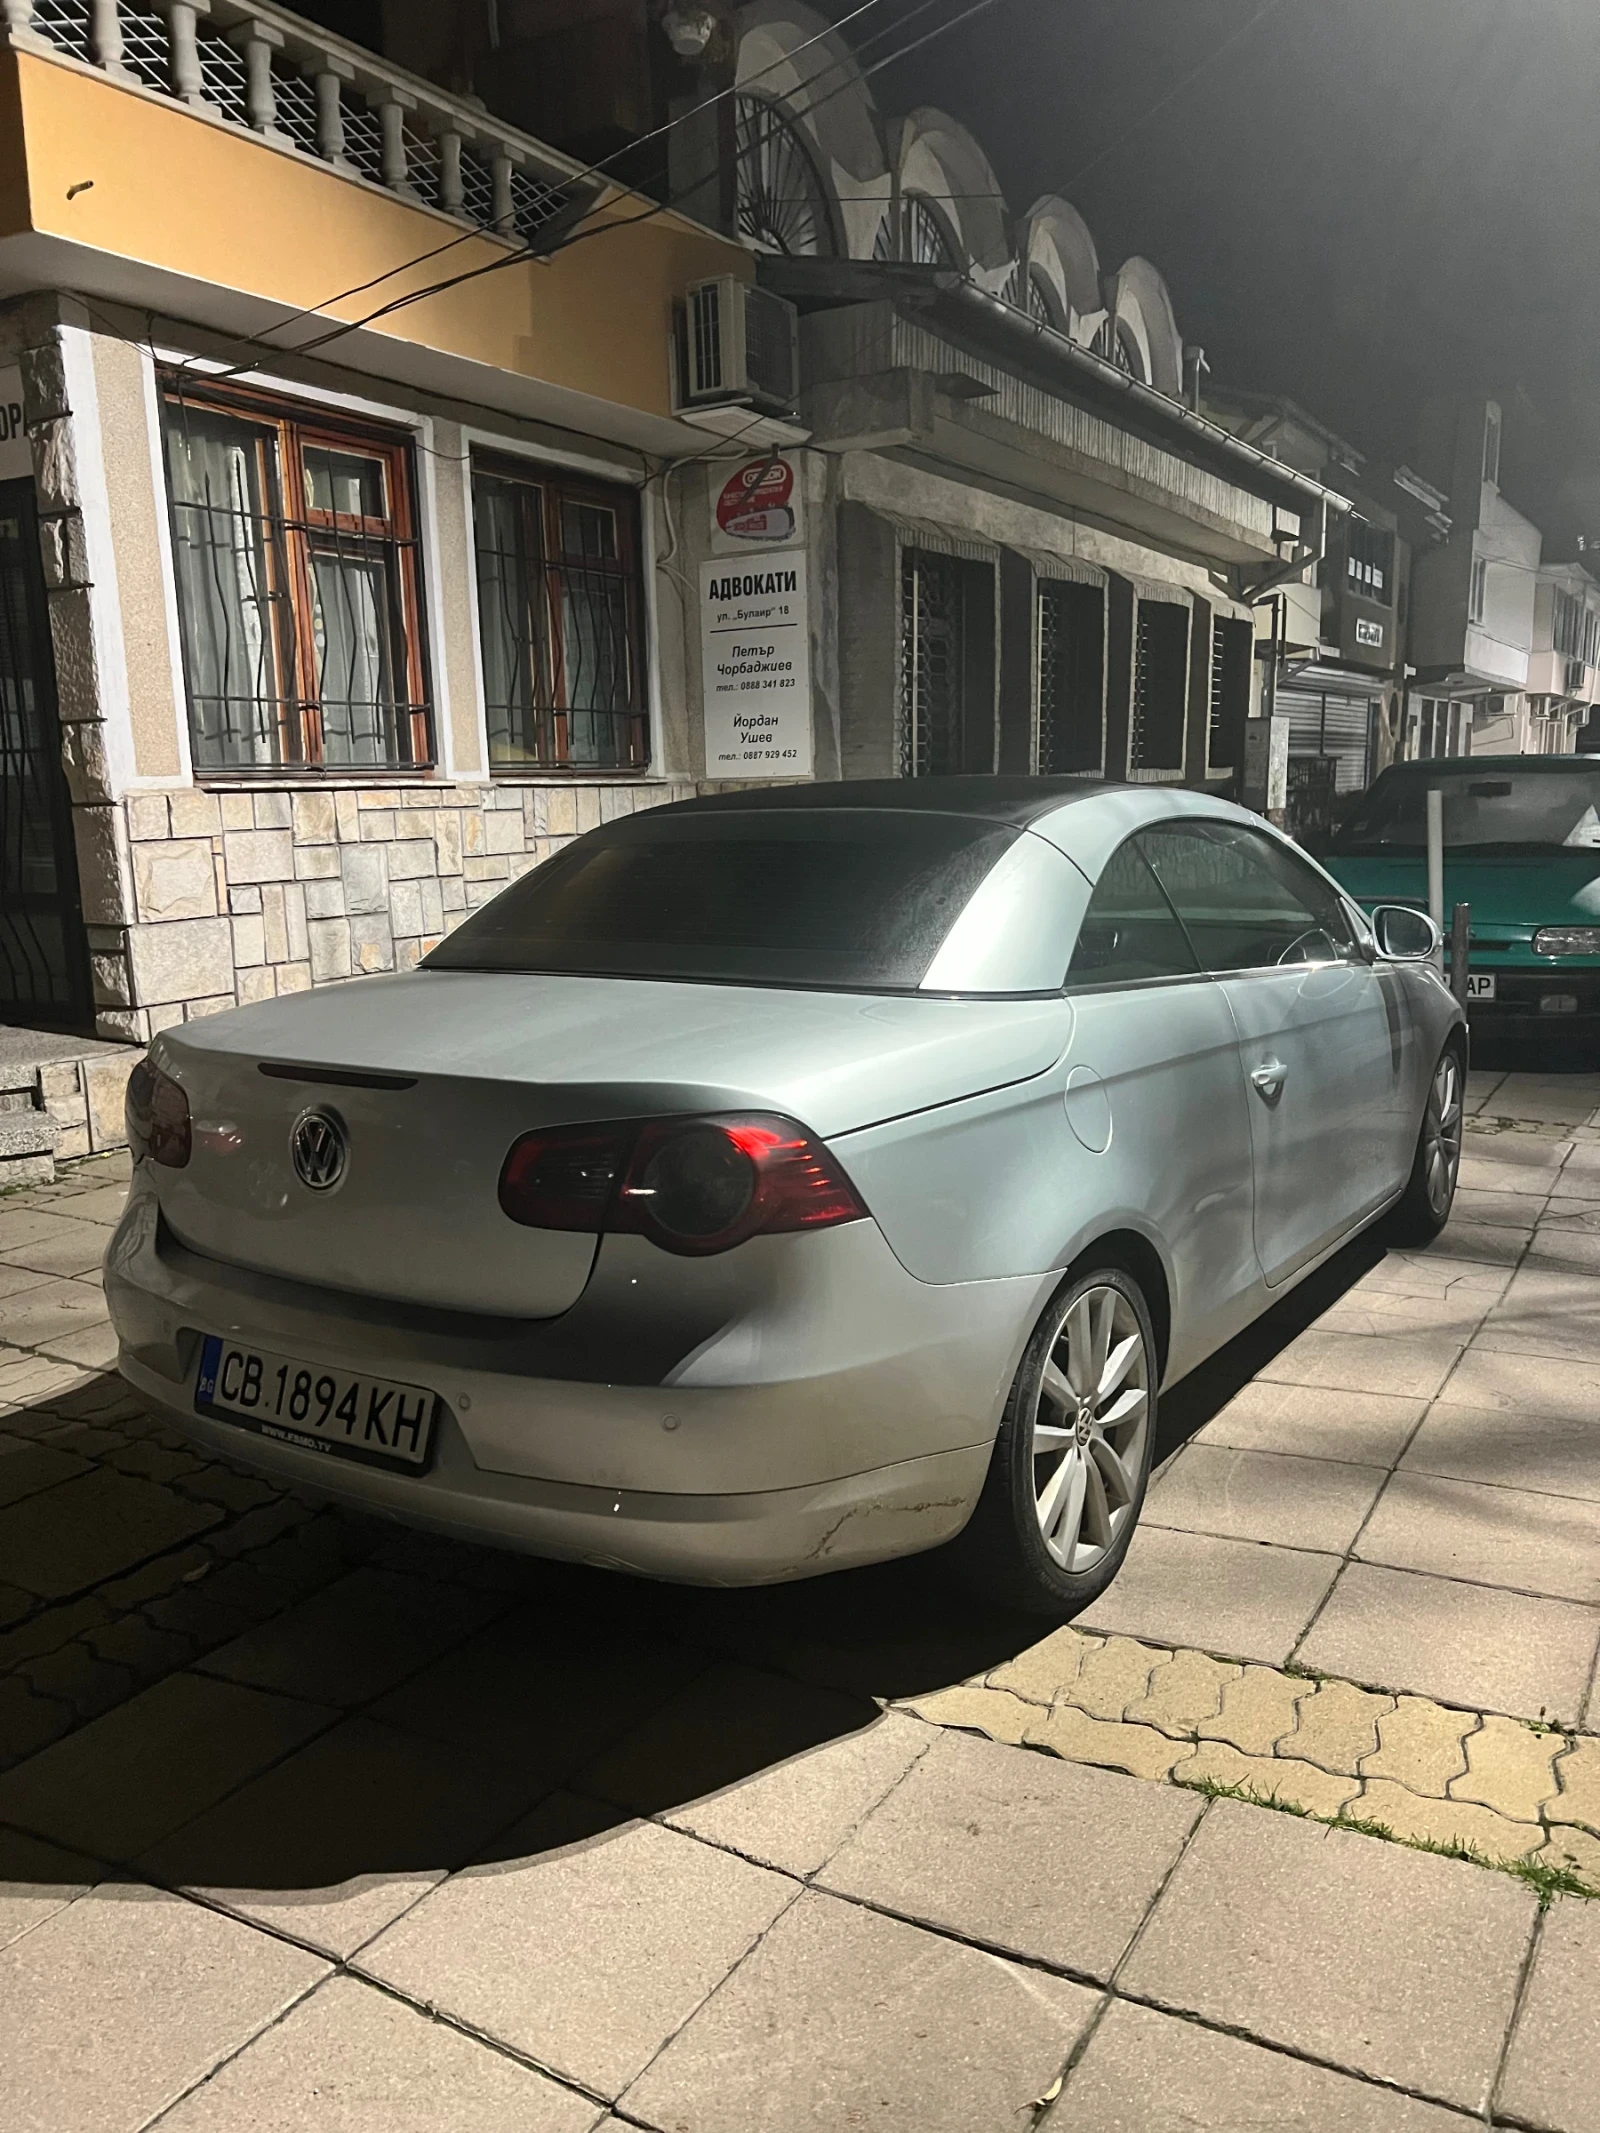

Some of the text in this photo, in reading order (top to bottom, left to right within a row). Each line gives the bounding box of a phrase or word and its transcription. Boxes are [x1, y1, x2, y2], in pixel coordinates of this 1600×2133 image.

[709, 570, 797, 602] АДВОКАТИ
[717, 613, 731, 623] ул.
[779, 605, 790, 615] 18
[732, 645, 775, 658] Петър
[717, 660, 793, 678] Чорбаджиев
[740, 681, 761, 691] 0888
[762, 679, 777, 689] 341
[779, 678, 796, 688] 823
[733, 713, 779, 730] Йордан
[740, 731, 773, 744] Ушев
[743, 750, 763, 760] 0887
[764, 749, 780, 759] 929
[782, 748, 798, 758] 452
[199, 1377, 214, 1393] BG
